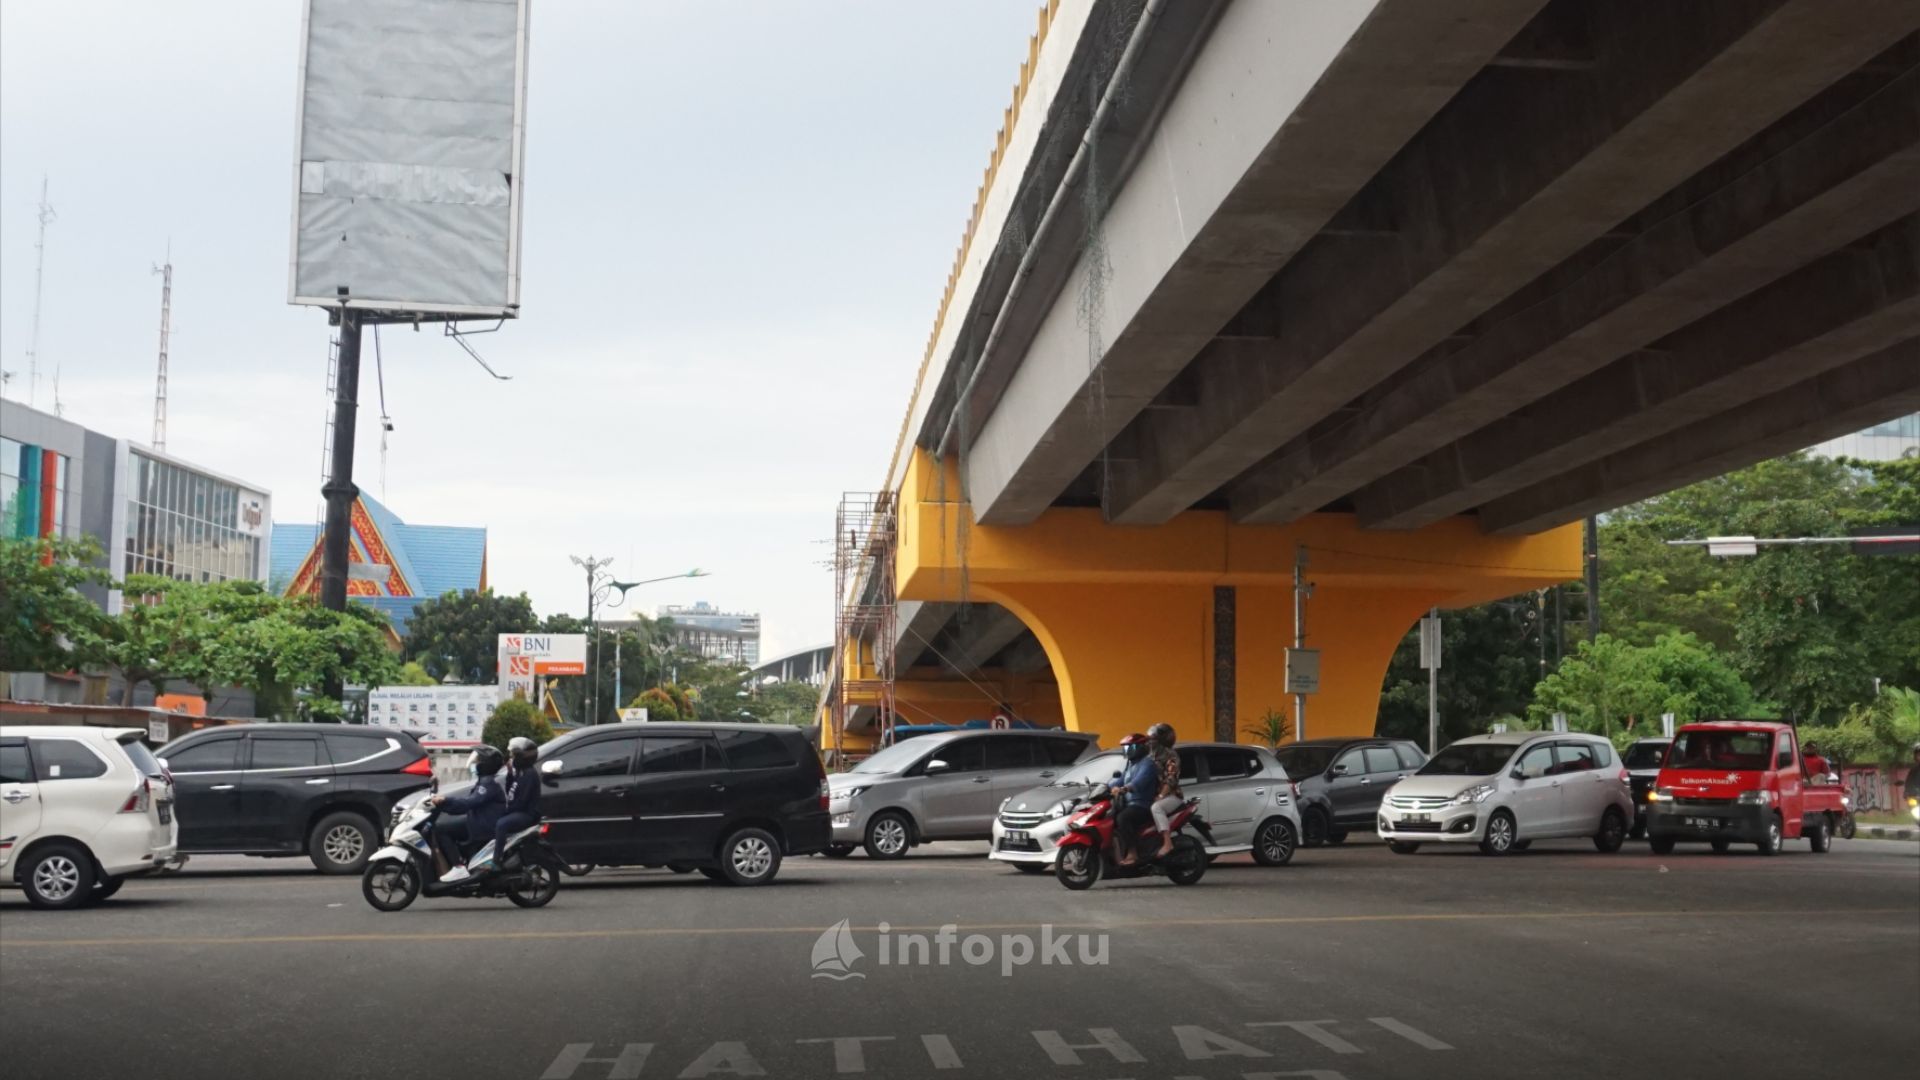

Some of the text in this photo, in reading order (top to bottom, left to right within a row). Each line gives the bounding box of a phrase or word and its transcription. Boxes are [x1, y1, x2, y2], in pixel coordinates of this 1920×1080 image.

[524, 637, 550, 651] BNI
[508, 681, 530, 691] BNI
[539, 1016, 1456, 1079] HATI HATI
